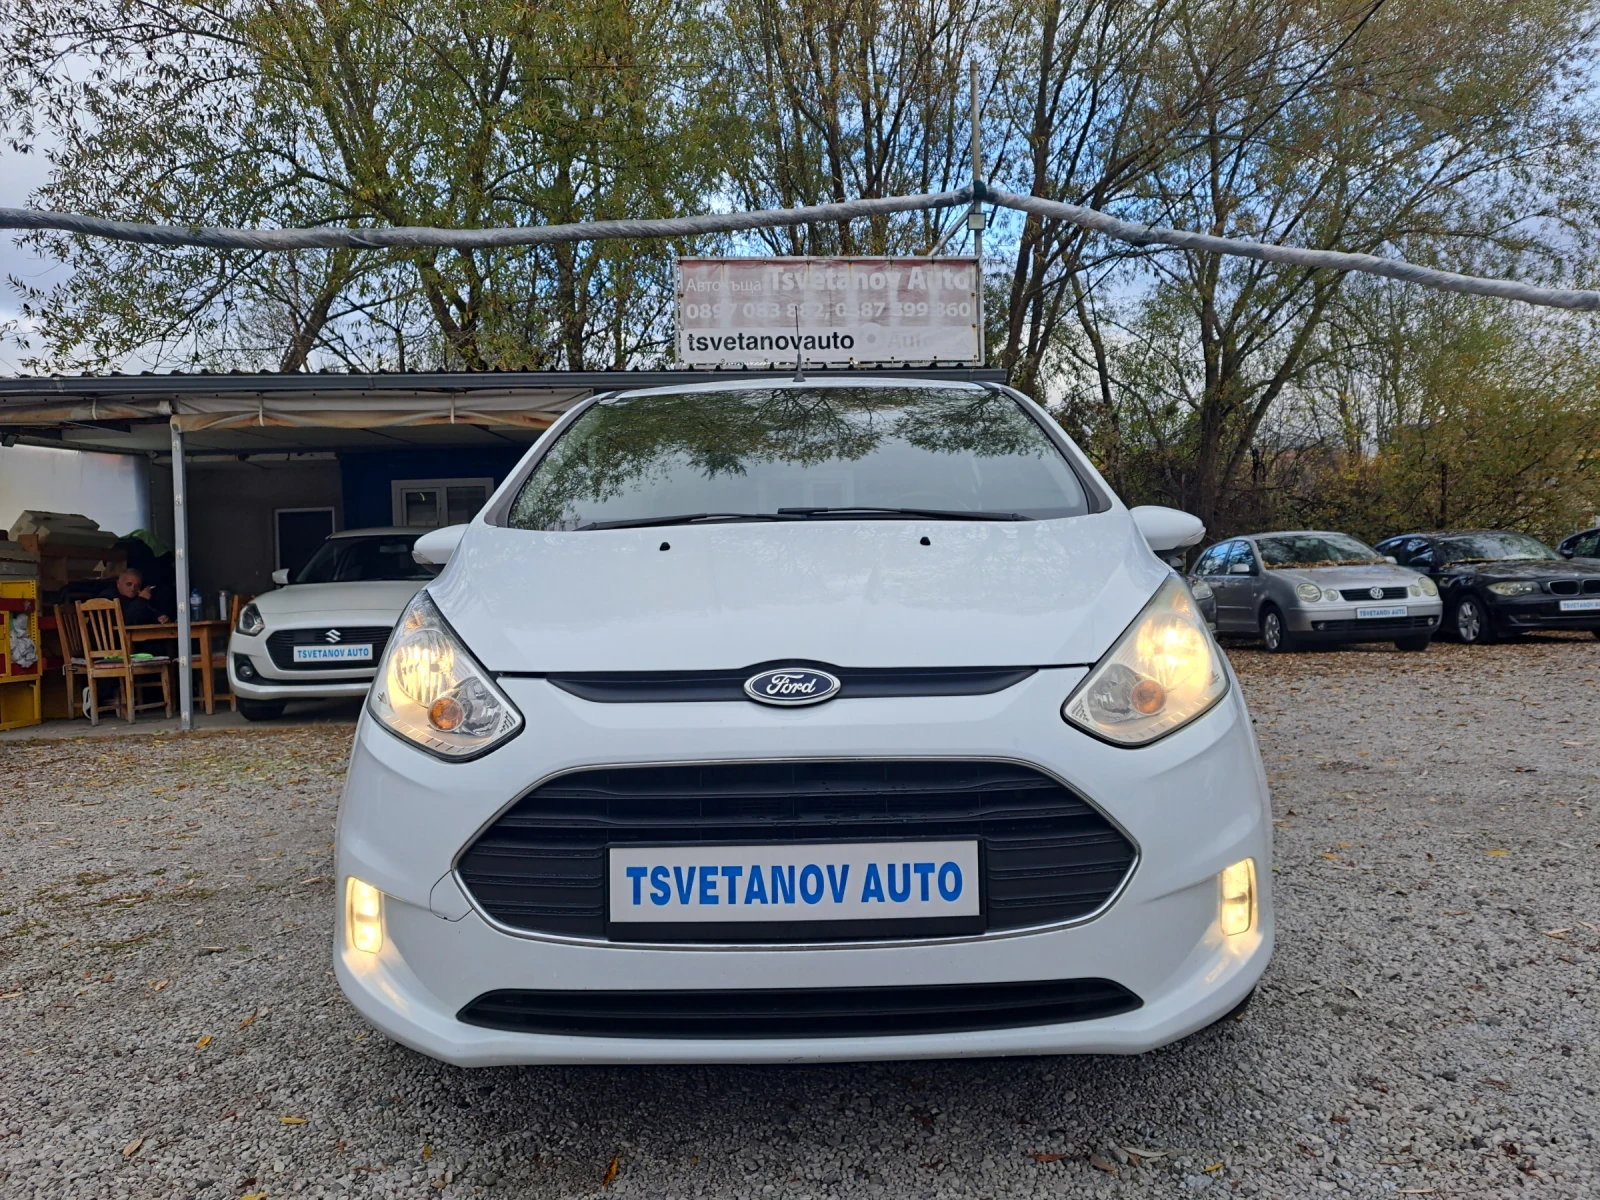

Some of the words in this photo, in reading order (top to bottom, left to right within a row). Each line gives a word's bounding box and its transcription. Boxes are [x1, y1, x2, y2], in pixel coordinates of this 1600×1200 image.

[768, 267, 901, 290] Tsvetanov
[907, 266, 970, 290] Auto
[688, 331, 855, 352] tsvetanovauto
[1391, 608, 1406, 616] AUTO
[297, 648, 345, 659] TSVETANOV
[347, 647, 369, 657] AUTO
[766, 674, 817, 695] Ford
[626, 864, 850, 906] TSVETANOV
[861, 861, 963, 903] AUTO
